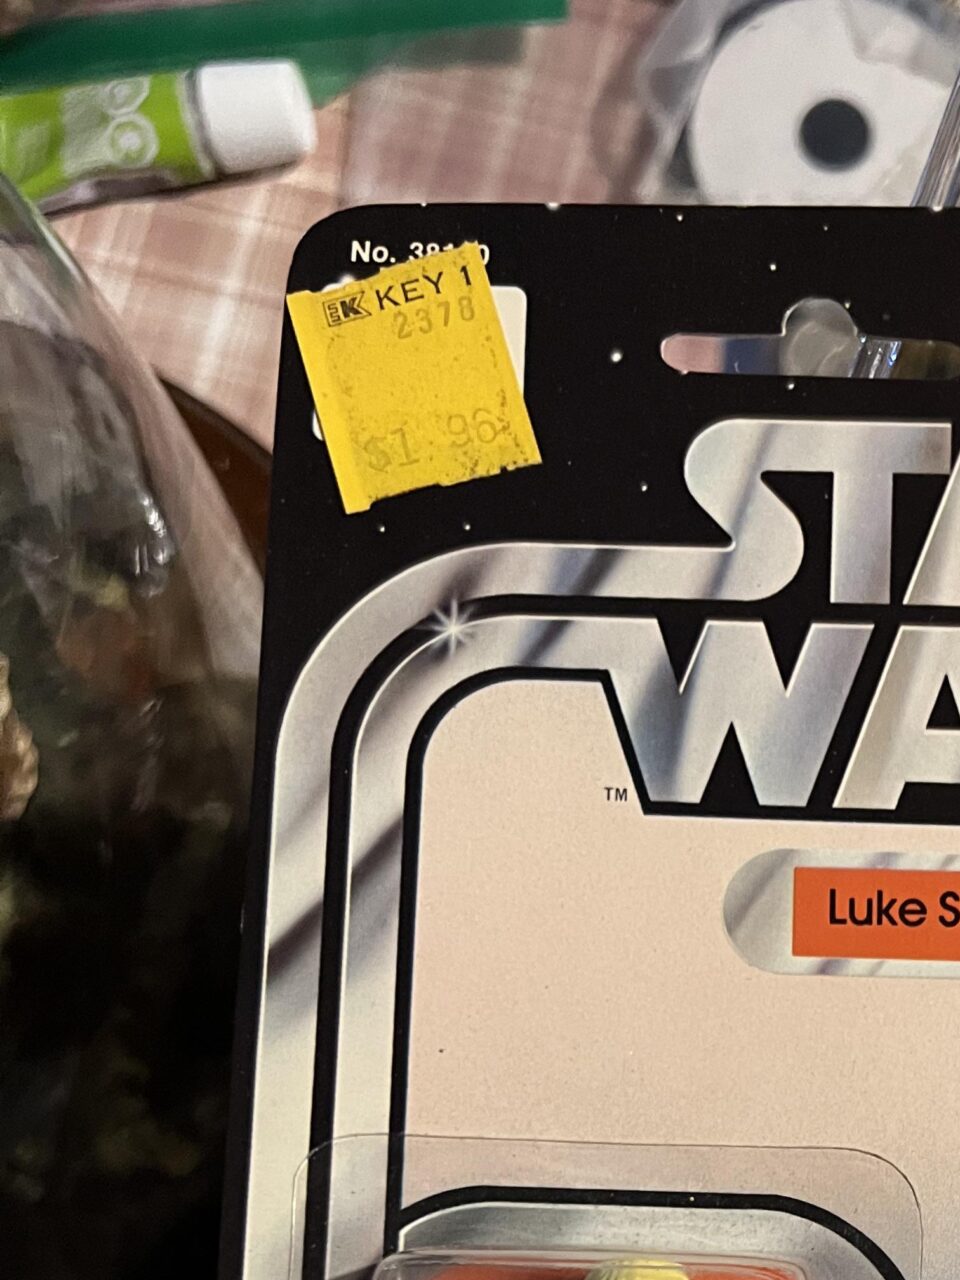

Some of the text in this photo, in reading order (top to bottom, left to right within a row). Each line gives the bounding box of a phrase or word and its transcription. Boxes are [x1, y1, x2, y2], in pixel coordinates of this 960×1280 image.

[350, 240, 396, 263] No.
[375, 265, 473, 311] KEY 1
[604, 787, 628, 802] TM
[829, 888, 927, 927] Luke
